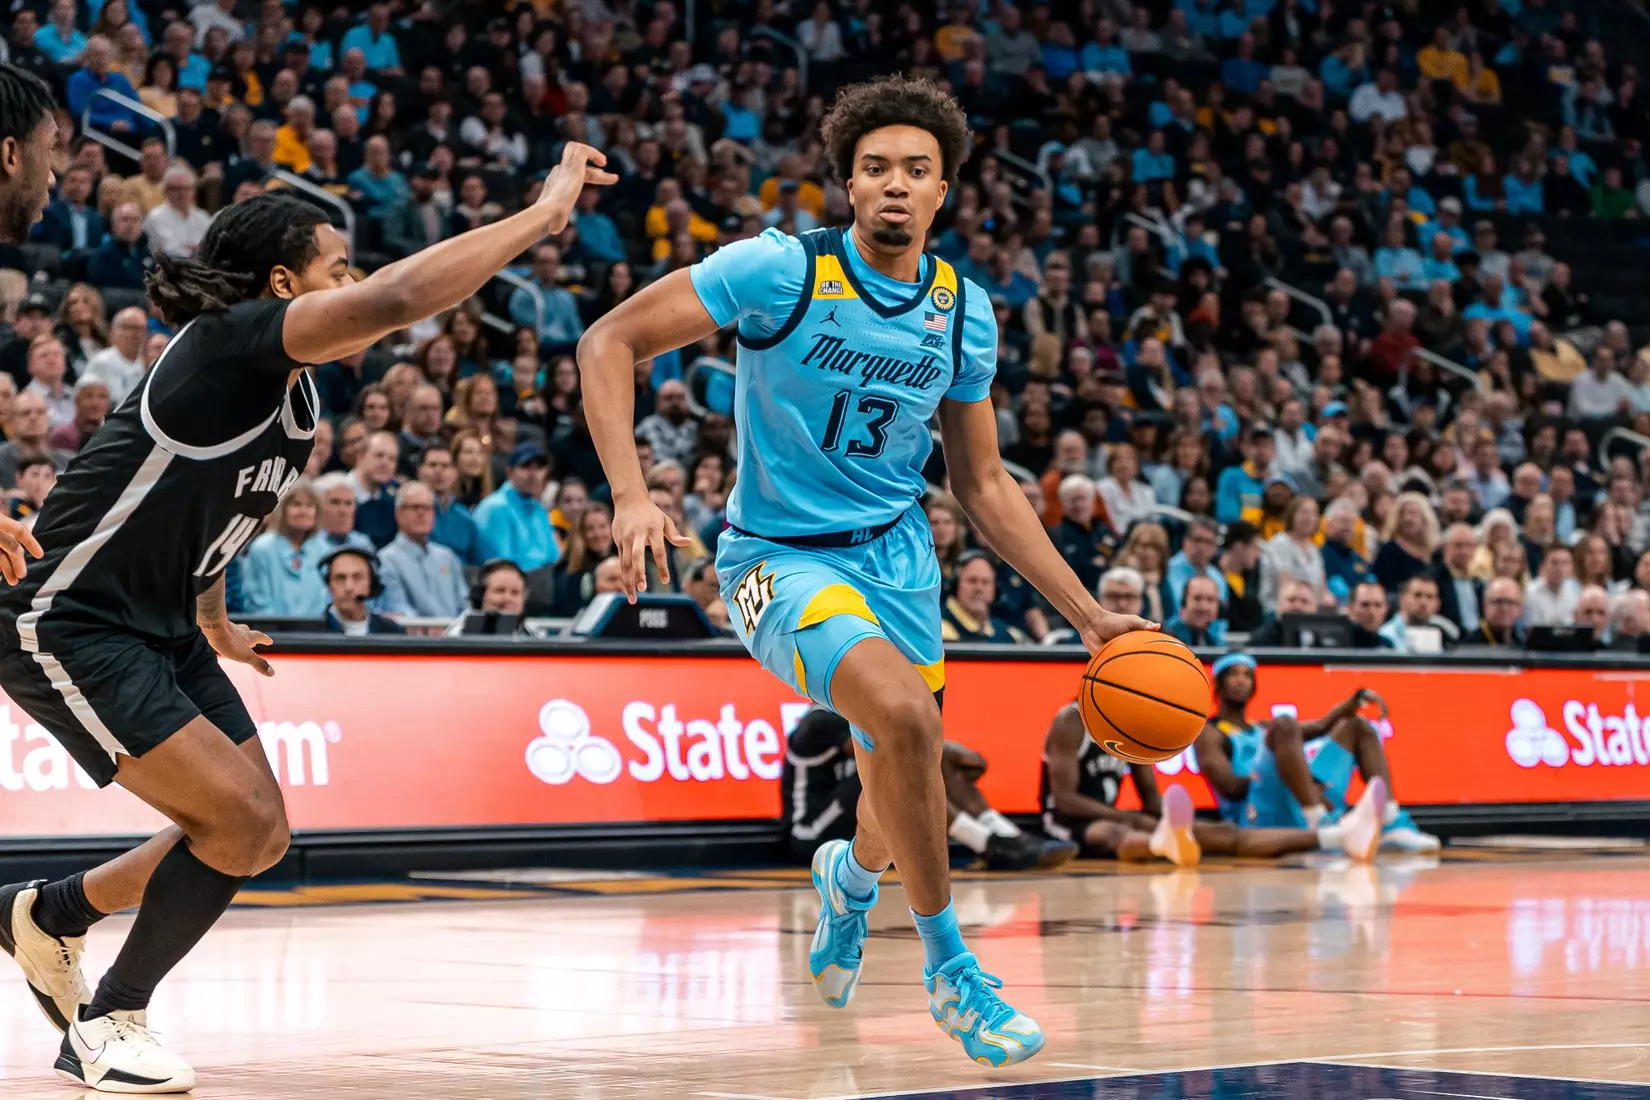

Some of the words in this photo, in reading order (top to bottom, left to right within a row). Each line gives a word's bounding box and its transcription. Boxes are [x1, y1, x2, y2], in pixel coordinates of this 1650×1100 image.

[801, 333, 941, 389] Marquette
[819, 389, 900, 459] 13
[622, 700, 783, 781] State
